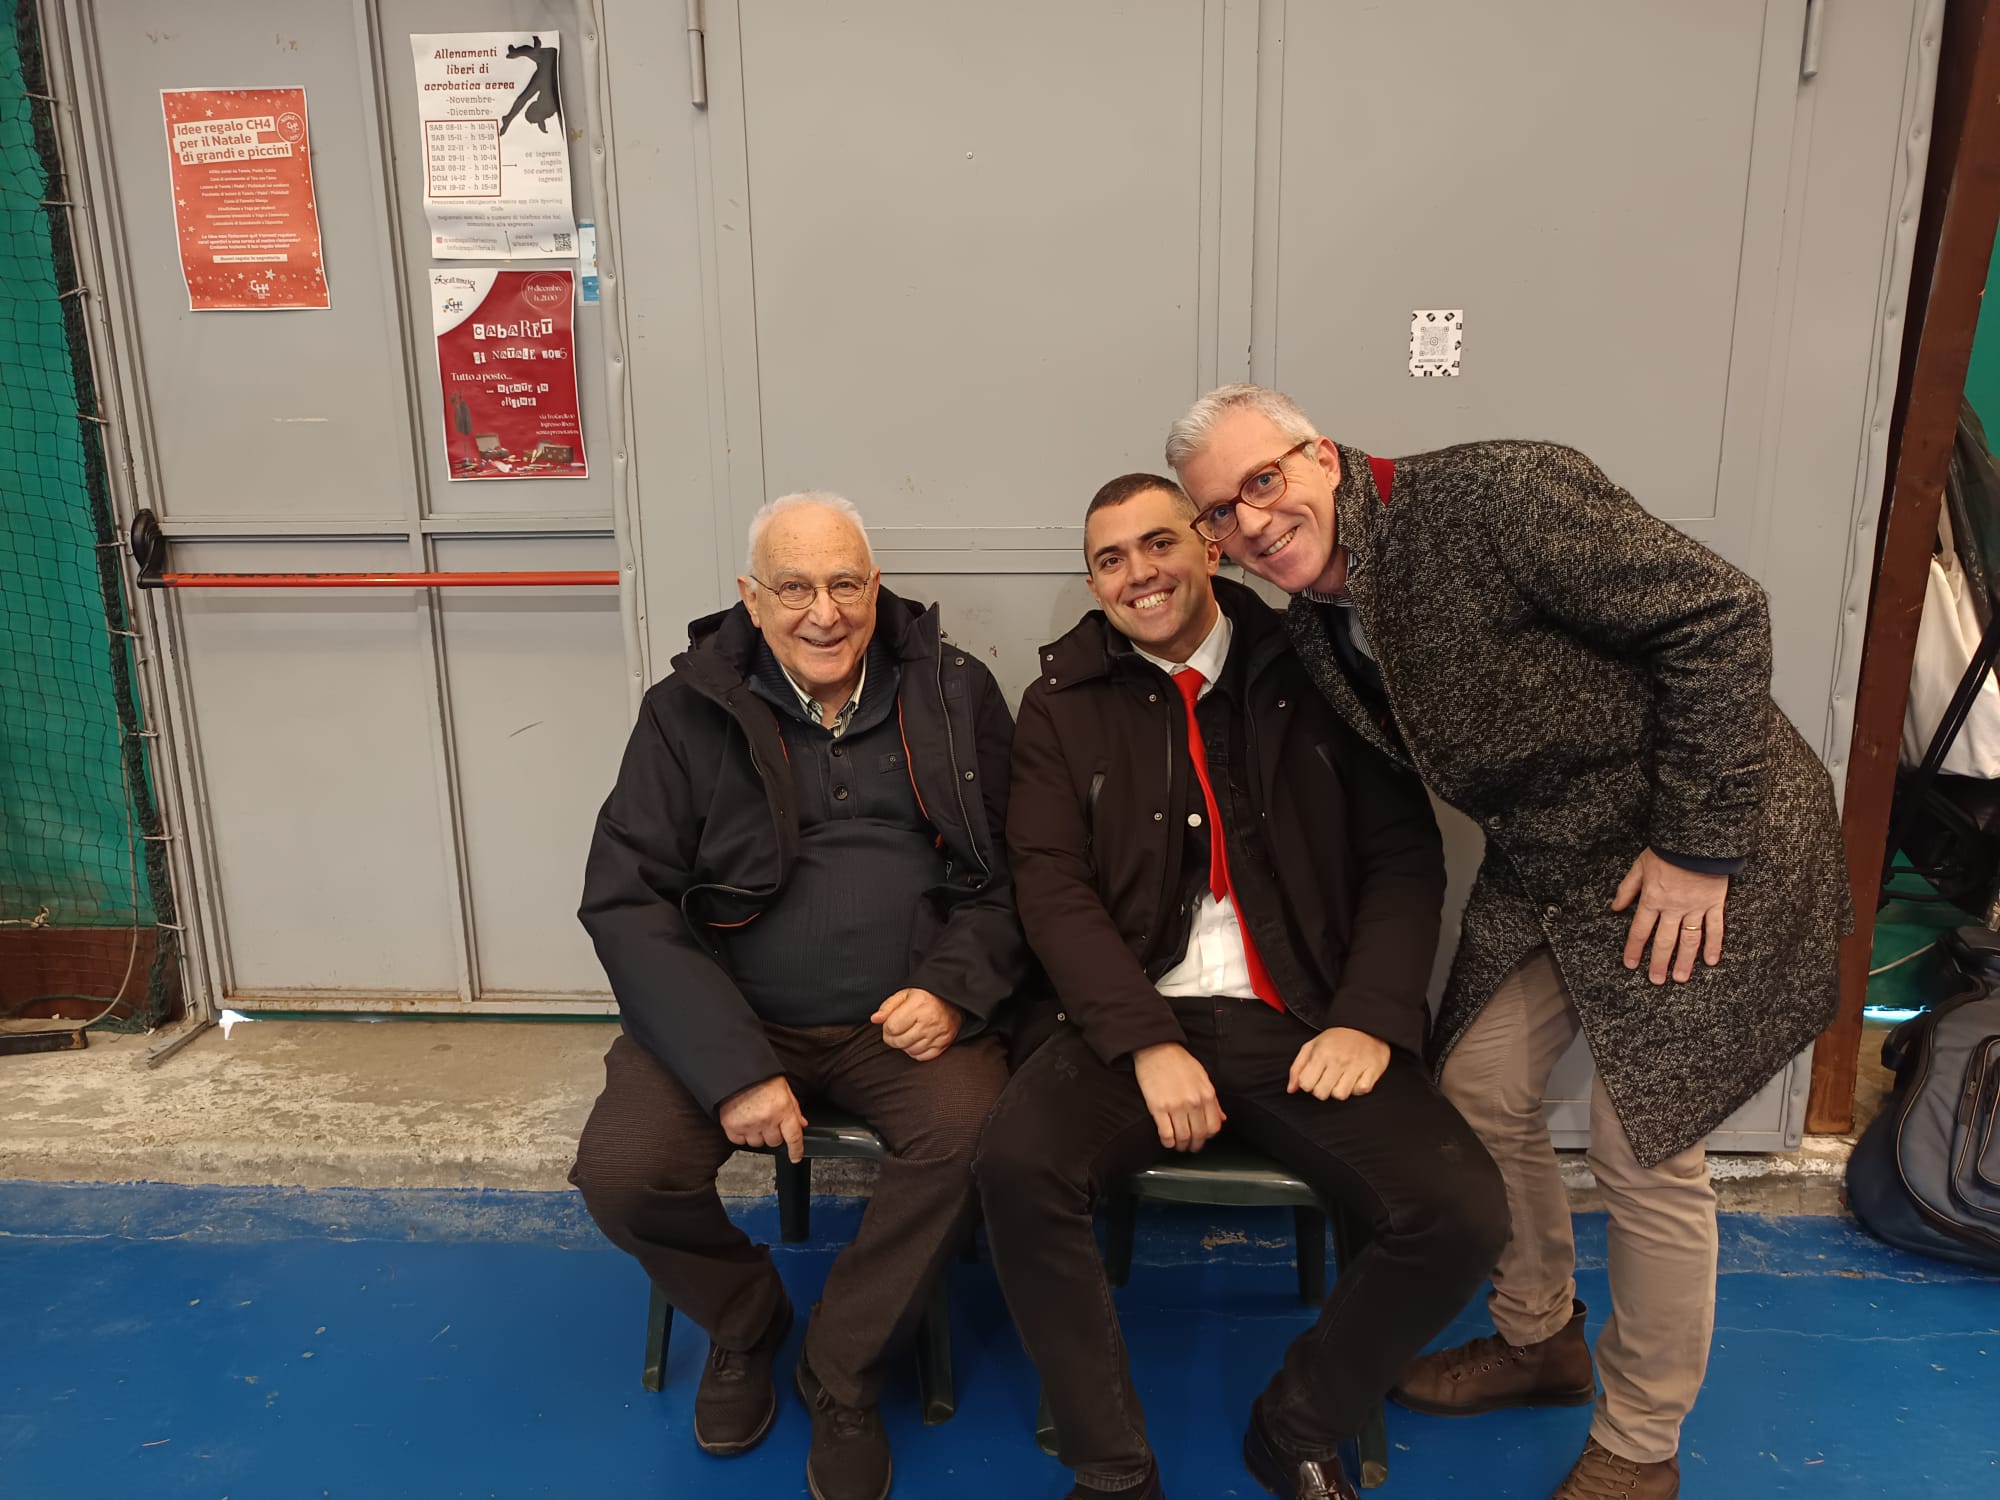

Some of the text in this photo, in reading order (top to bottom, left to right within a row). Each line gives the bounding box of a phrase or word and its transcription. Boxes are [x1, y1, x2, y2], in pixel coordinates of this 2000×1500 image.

[434, 46, 497, 59] Allenamenti
[446, 62, 489, 75] liberi di
[424, 80, 515, 91] acrobatica aerea
[177, 124, 201, 136] Idee
[204, 121, 244, 137] regalo
[246, 118, 271, 130] CH4
[180, 134, 252, 151] per il Natale
[182, 144, 290, 164] di grandi e piccini
[450, 372, 475, 381] Tutto
